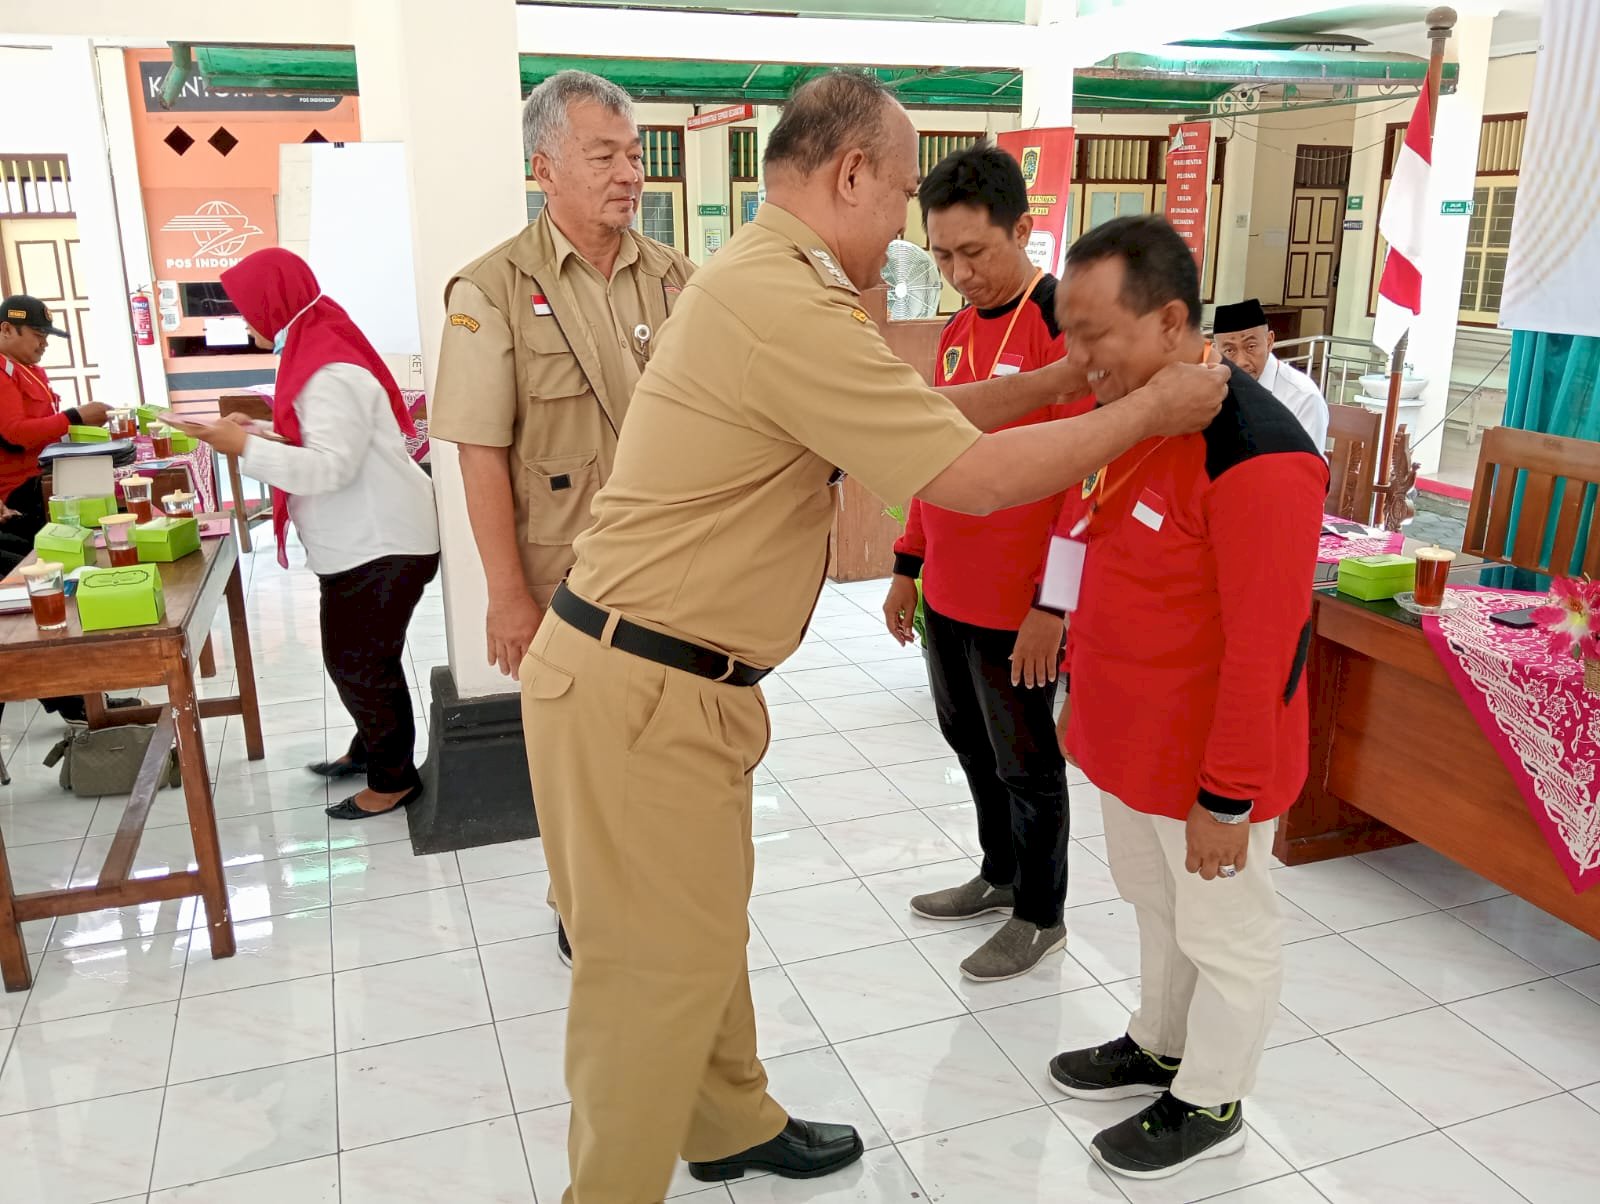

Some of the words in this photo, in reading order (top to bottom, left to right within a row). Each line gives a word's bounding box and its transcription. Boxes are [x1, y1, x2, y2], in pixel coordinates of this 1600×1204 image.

[166, 258, 192, 269] POS
[195, 258, 243, 268] INDON
[412, 354, 422, 375] KET
